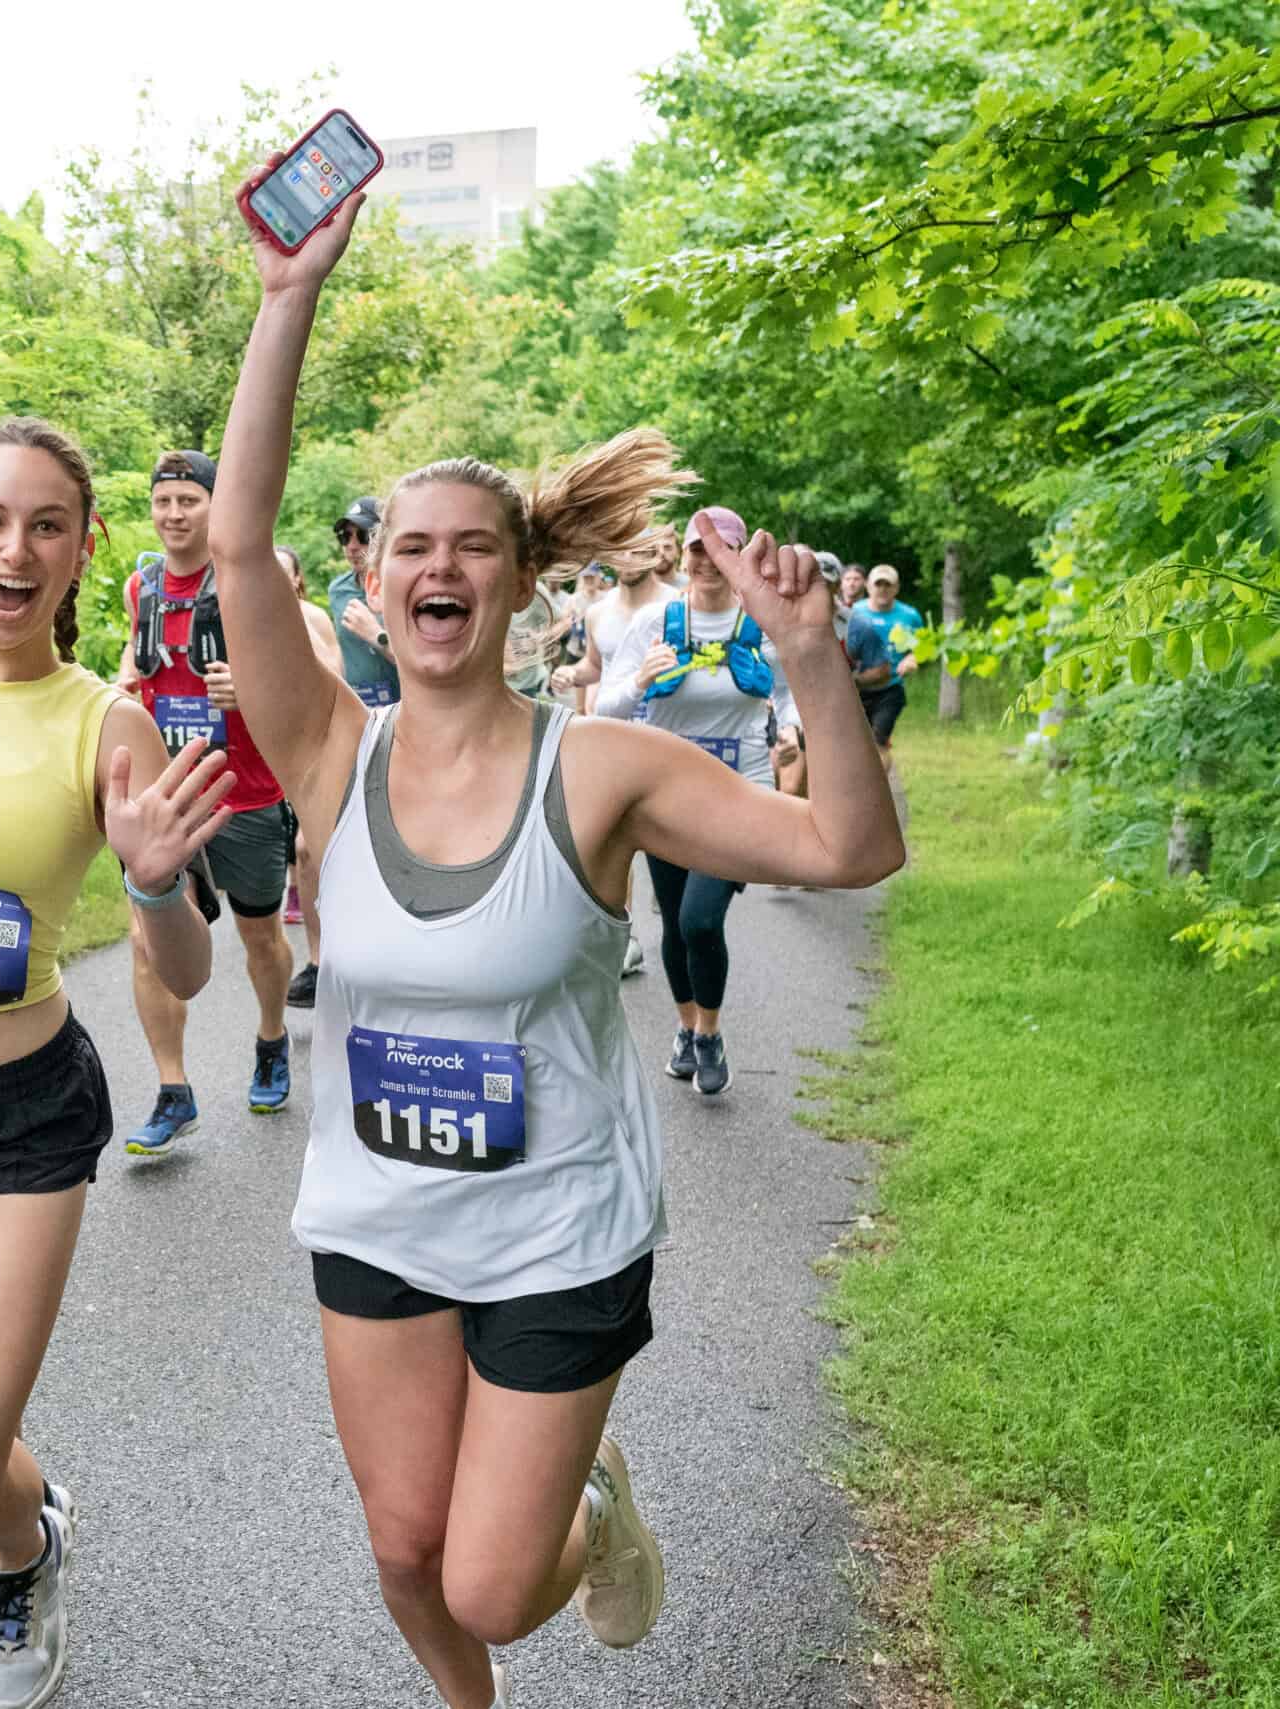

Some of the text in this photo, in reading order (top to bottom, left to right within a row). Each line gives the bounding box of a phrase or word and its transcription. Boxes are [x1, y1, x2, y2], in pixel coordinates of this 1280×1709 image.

[386, 1050, 465, 1071] riverrock
[379, 1079, 477, 1102] James River Scramble
[373, 1098, 488, 1158] 1151
